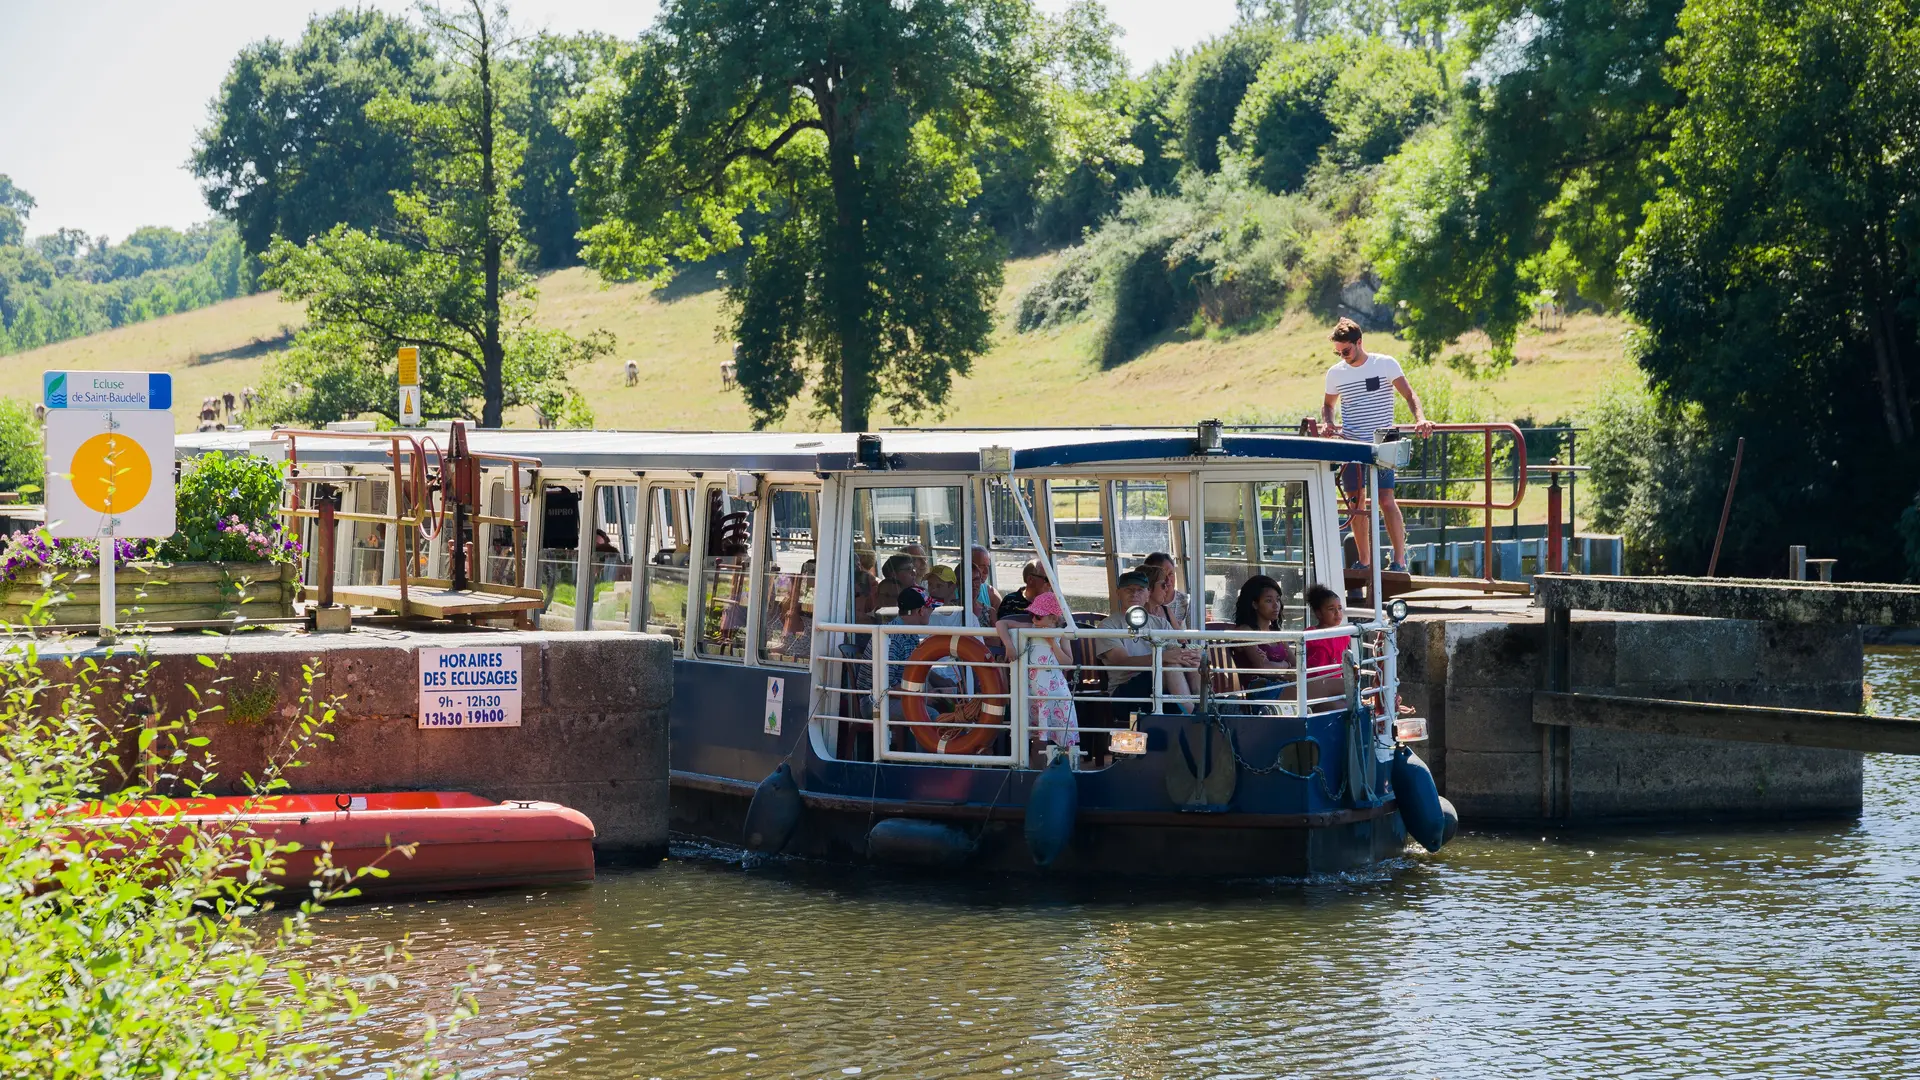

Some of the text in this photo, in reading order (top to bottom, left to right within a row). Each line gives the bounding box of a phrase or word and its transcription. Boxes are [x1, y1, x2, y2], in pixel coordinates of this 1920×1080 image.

[93, 379, 124, 389] Ecluse
[72, 392, 146, 403] de Saint-Baudelle
[439, 653, 503, 668] HORAIRES
[424, 670, 518, 686] DES ECLUSAGES
[438, 696, 454, 707] 9h
[466, 695, 501, 707] 12h30
[425, 709, 504, 726] 13h30 19h00
